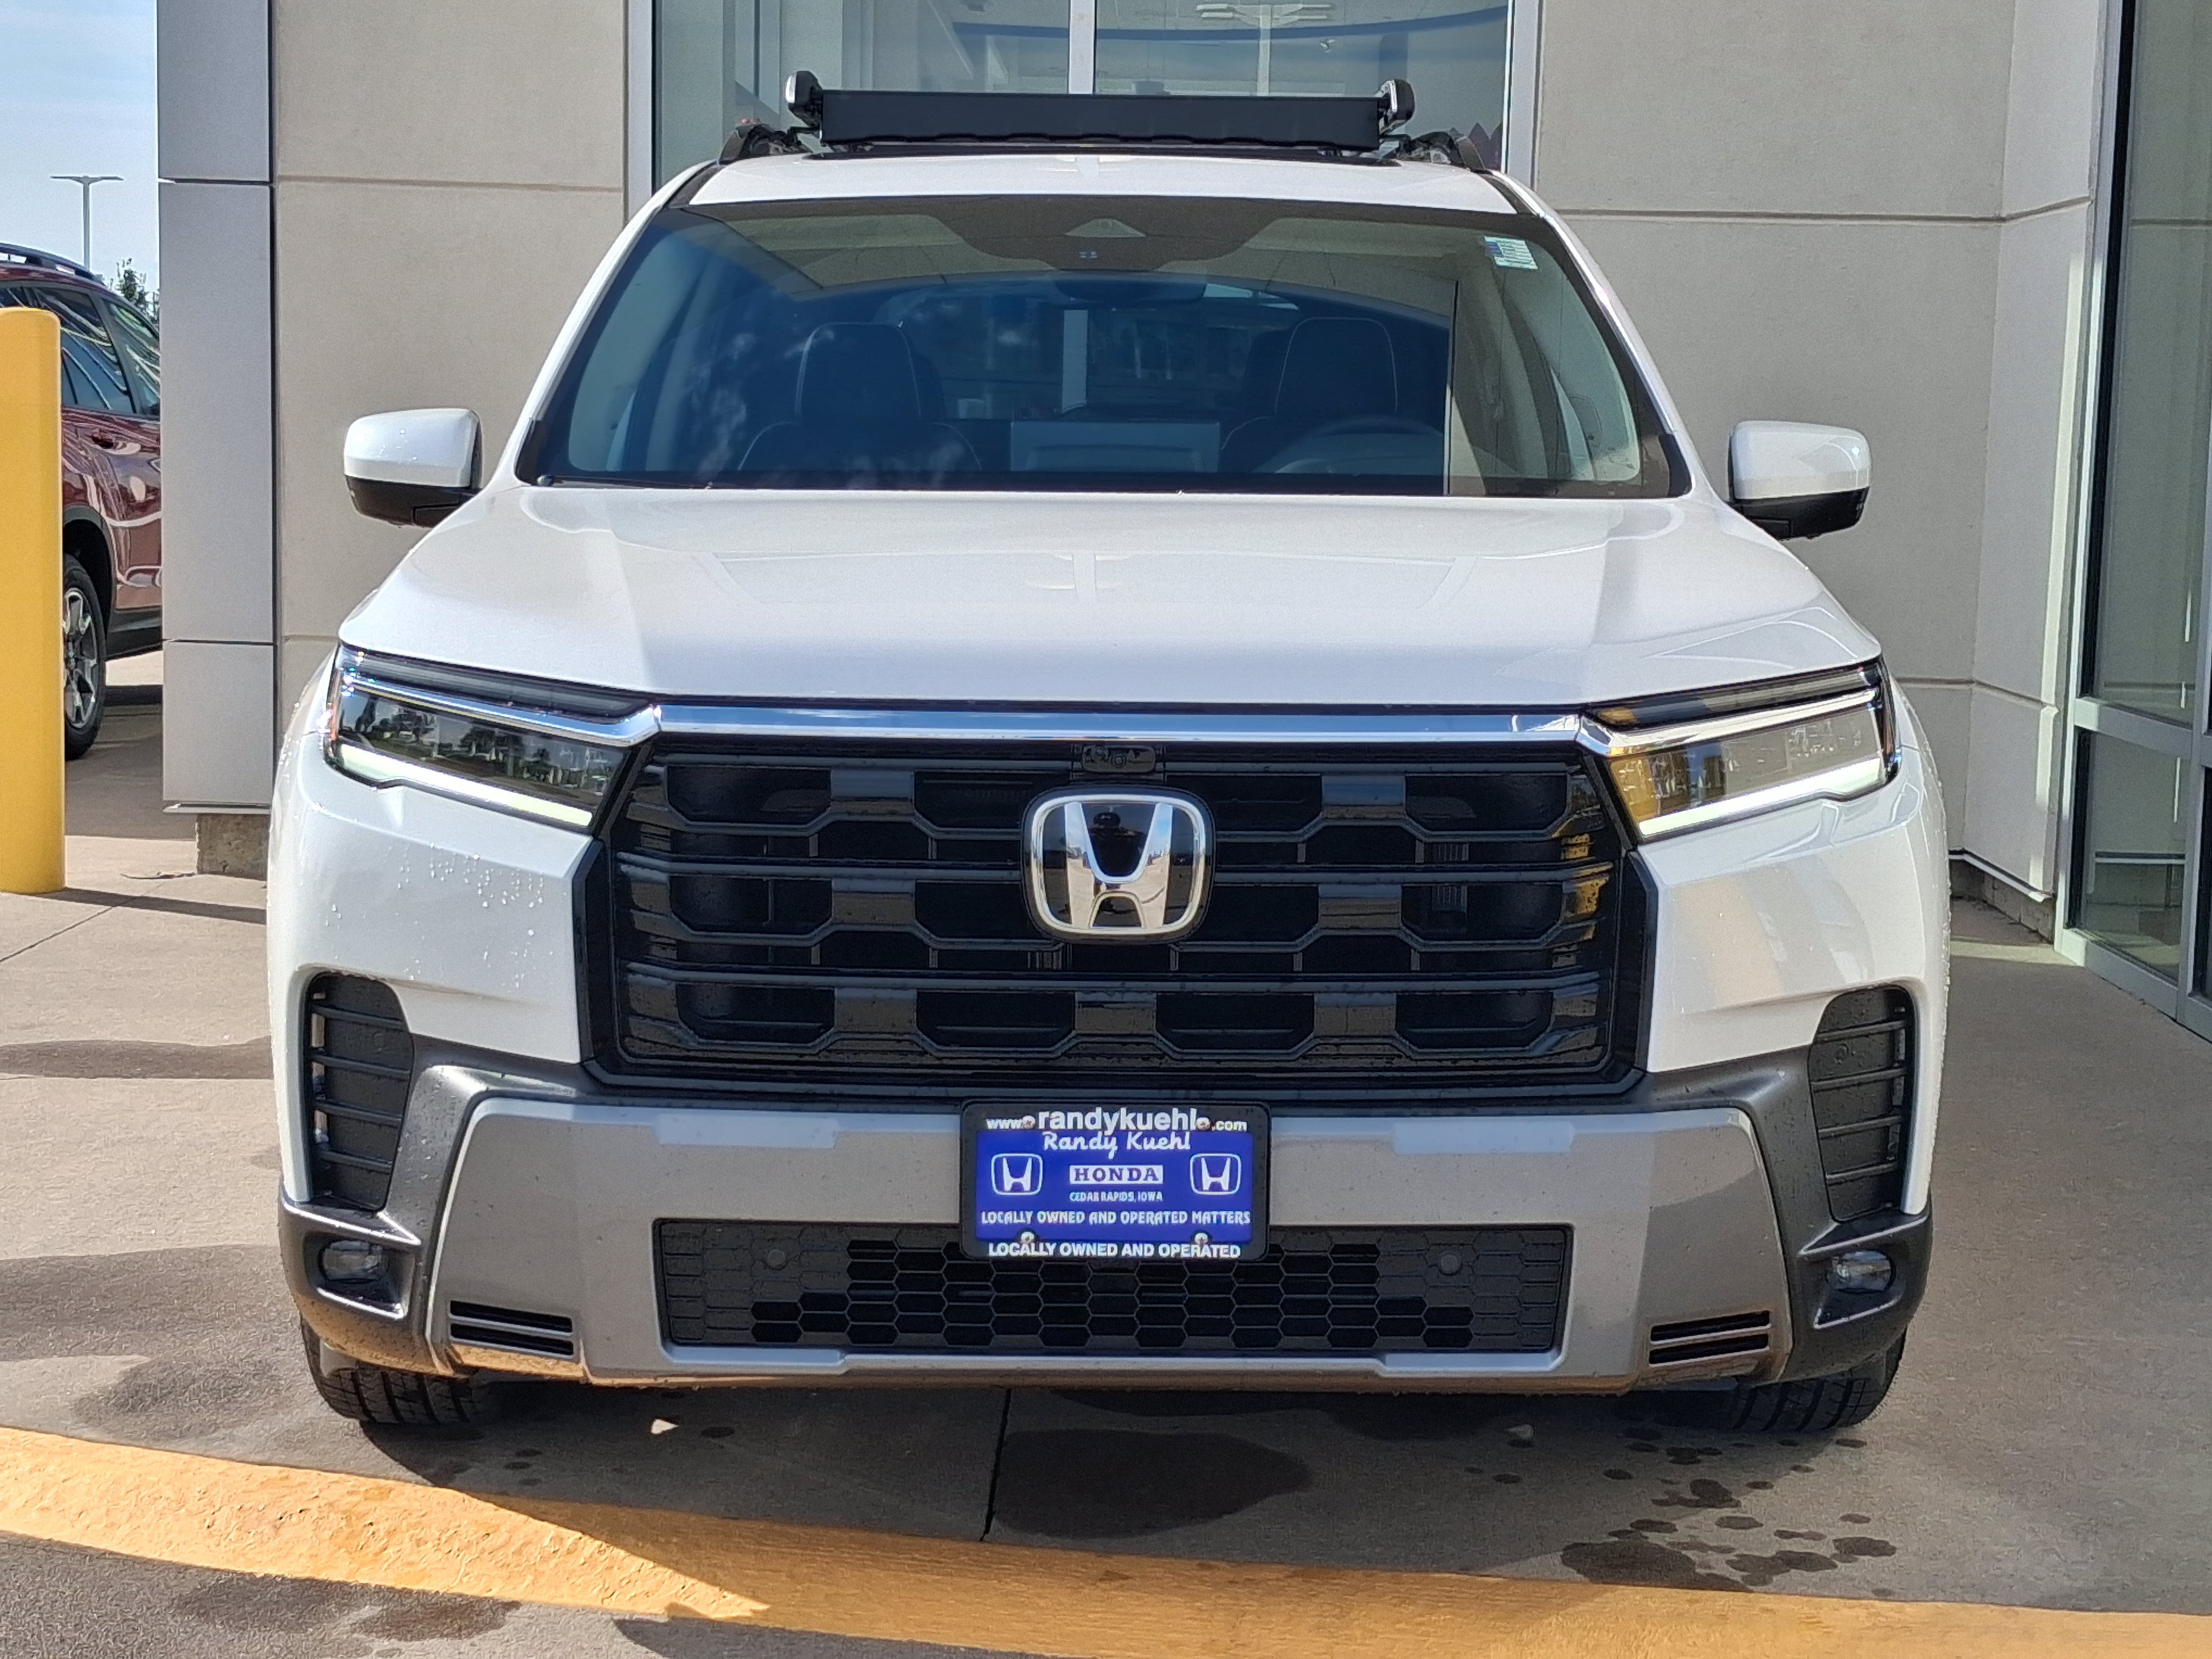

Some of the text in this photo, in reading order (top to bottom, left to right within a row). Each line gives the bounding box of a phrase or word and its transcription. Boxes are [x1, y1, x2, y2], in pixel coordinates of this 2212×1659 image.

[1042, 1131, 1191, 1159] Randy Kuehl
[1073, 1167, 1159, 1182] HONDA
[1069, 1191, 1099, 1202] CEDAR
[1137, 1191, 1163, 1202] IOWA
[981, 1211, 1251, 1225] LOCALLY OWNED AND OPERATED MATTERS
[988, 1243, 1241, 1258] LOCALLY OWNED AND OPERATED
